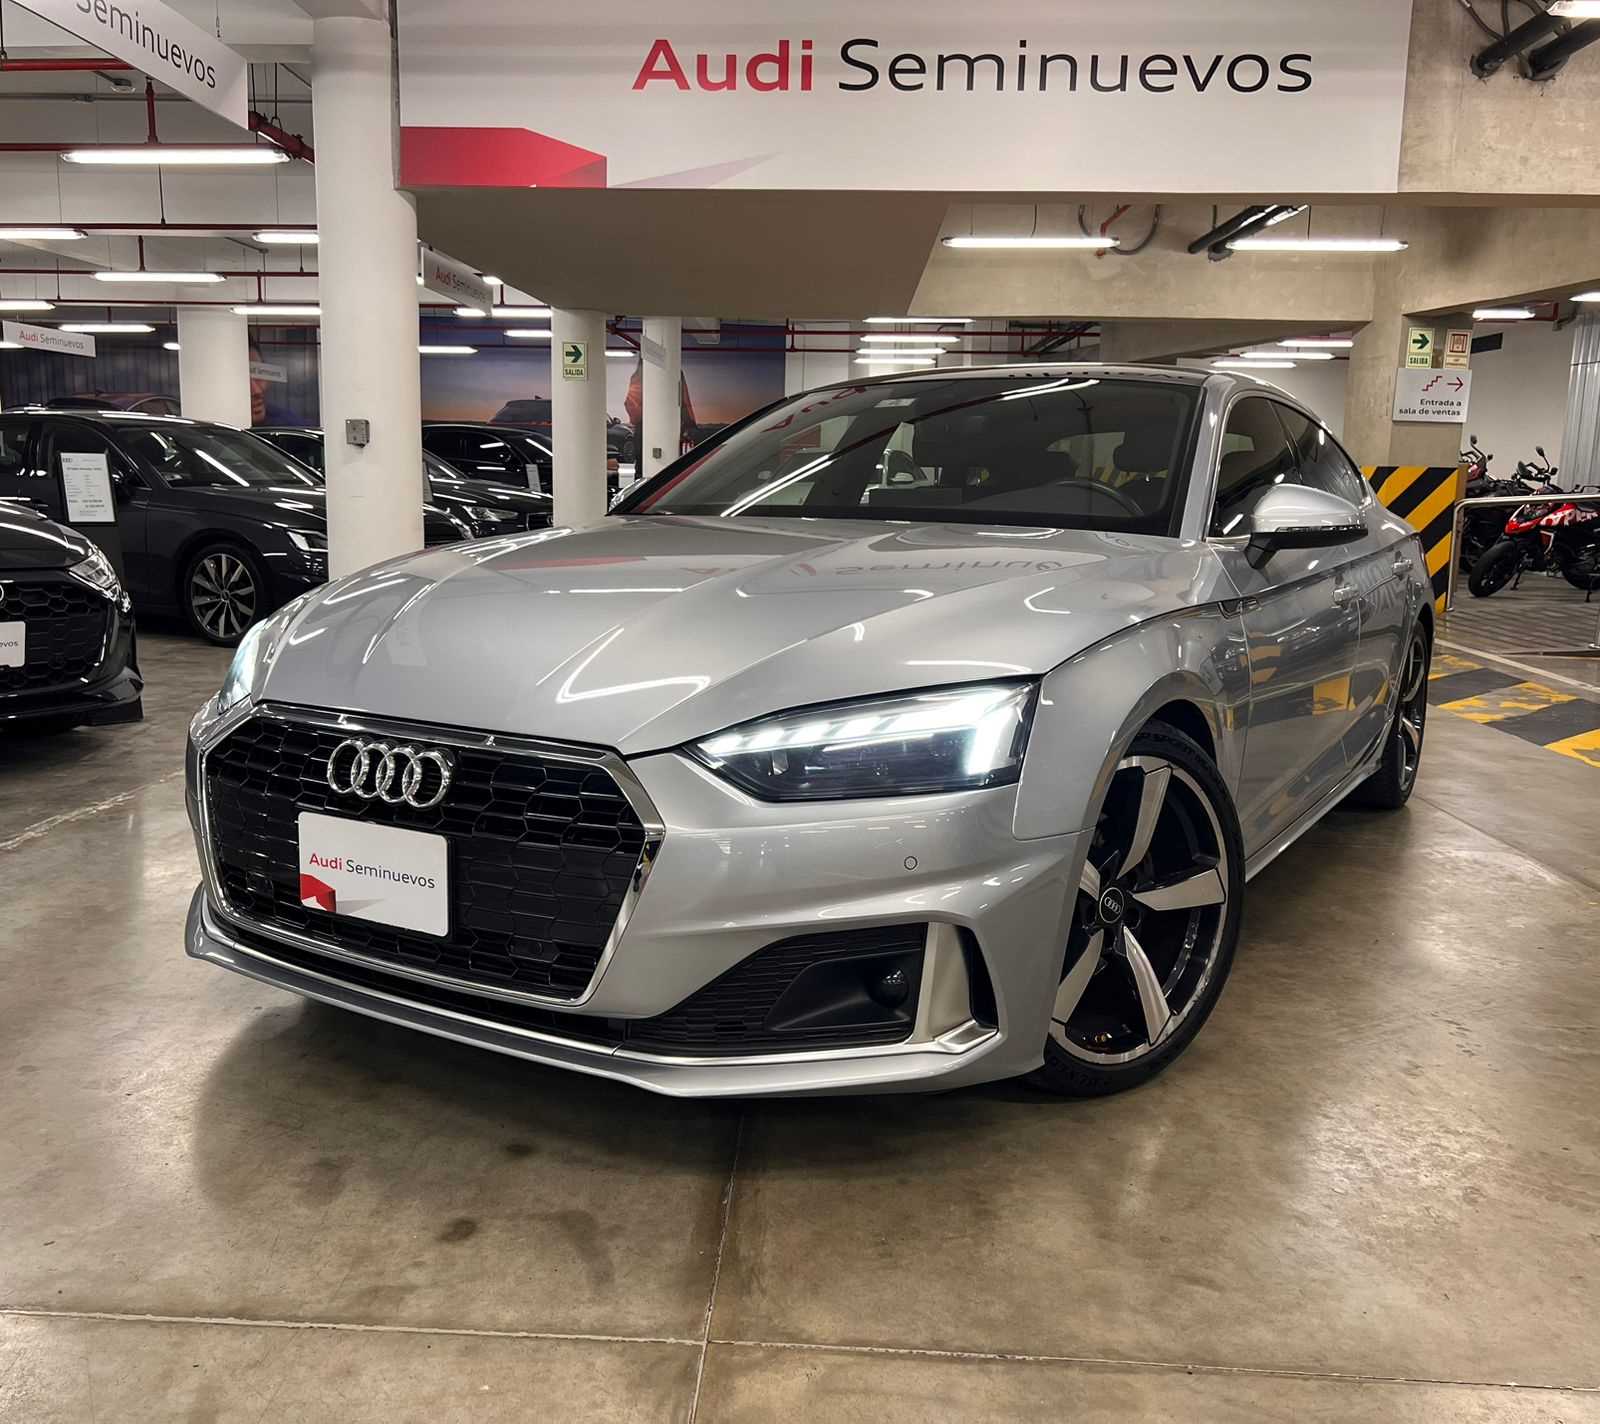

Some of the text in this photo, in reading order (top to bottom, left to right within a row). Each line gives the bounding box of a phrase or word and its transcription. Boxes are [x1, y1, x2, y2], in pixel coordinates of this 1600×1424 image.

[632, 38, 1313, 93] Audi Seminuevos
[20, 330, 38, 342] Audi
[309, 853, 435, 889] Audi Seminuevos
